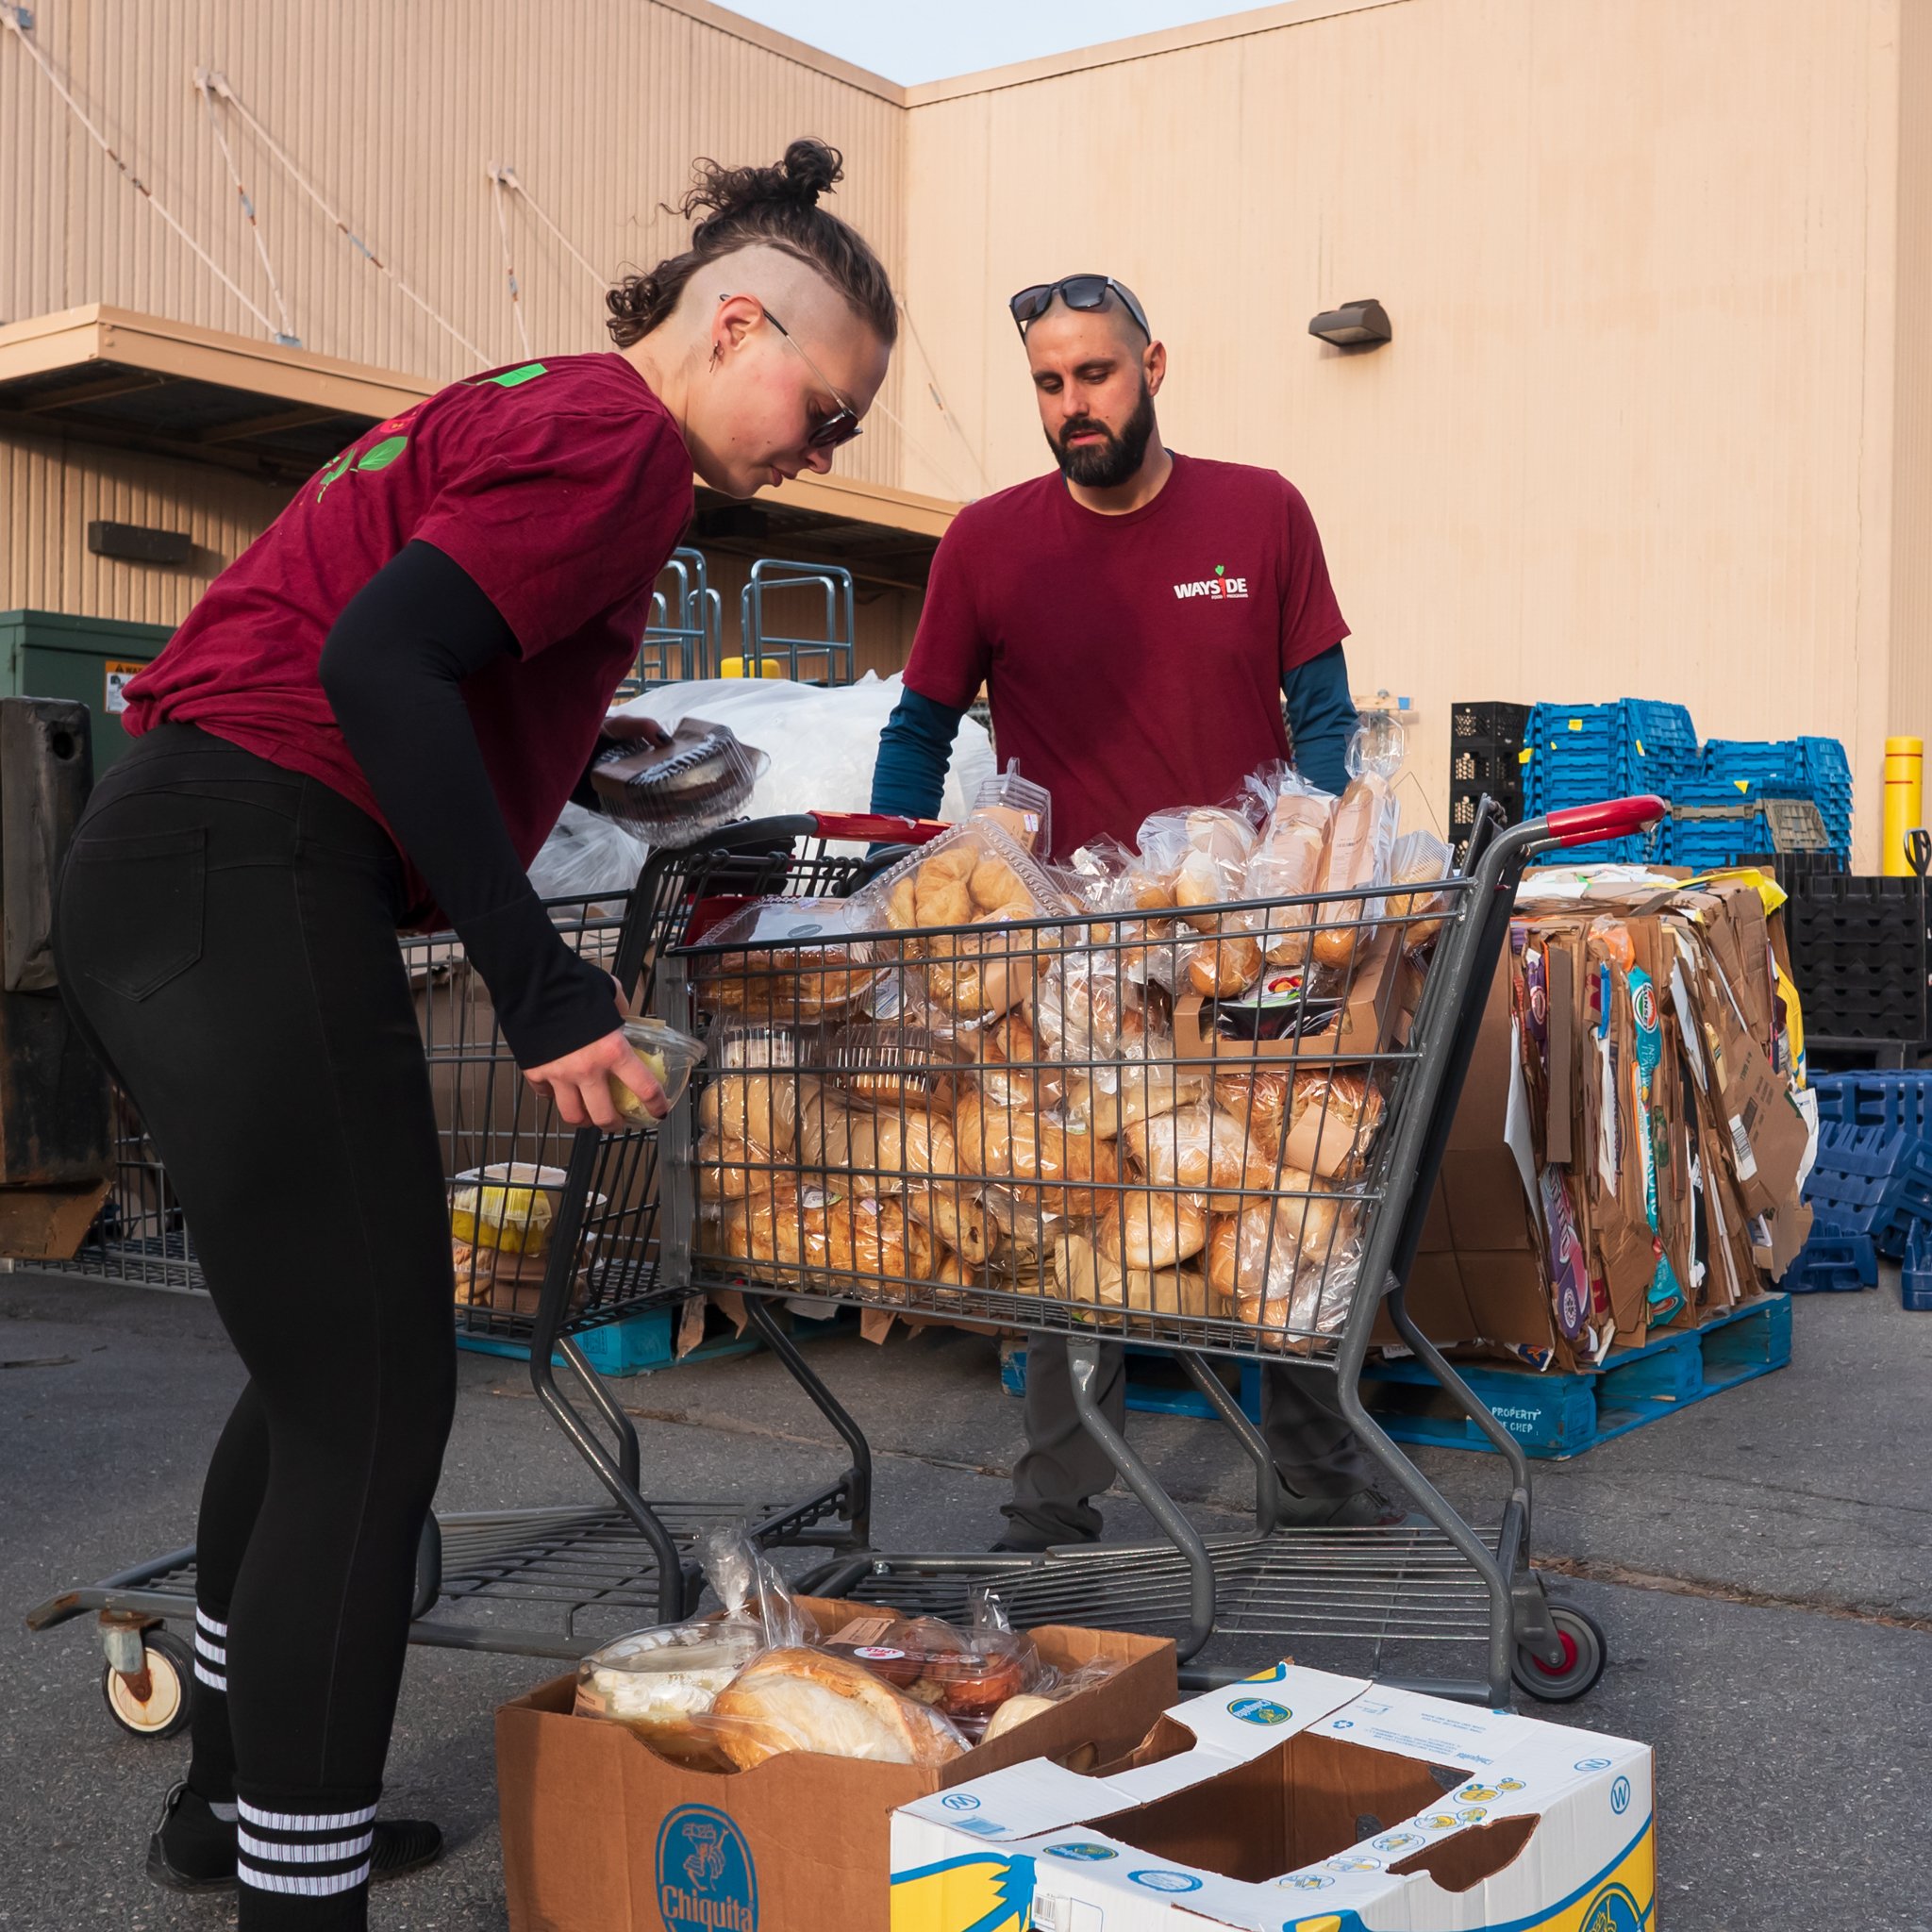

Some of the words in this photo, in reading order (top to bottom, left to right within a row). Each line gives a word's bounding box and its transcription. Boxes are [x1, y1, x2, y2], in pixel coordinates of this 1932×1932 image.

[1174, 577, 1247, 599] WAYSIDE
[1491, 1407, 1541, 1421] PROPERTY
[1510, 1423, 1533, 1433] CHEP
[1613, 1783, 1627, 1808] W
[662, 1885, 753, 1932] Chiquita
